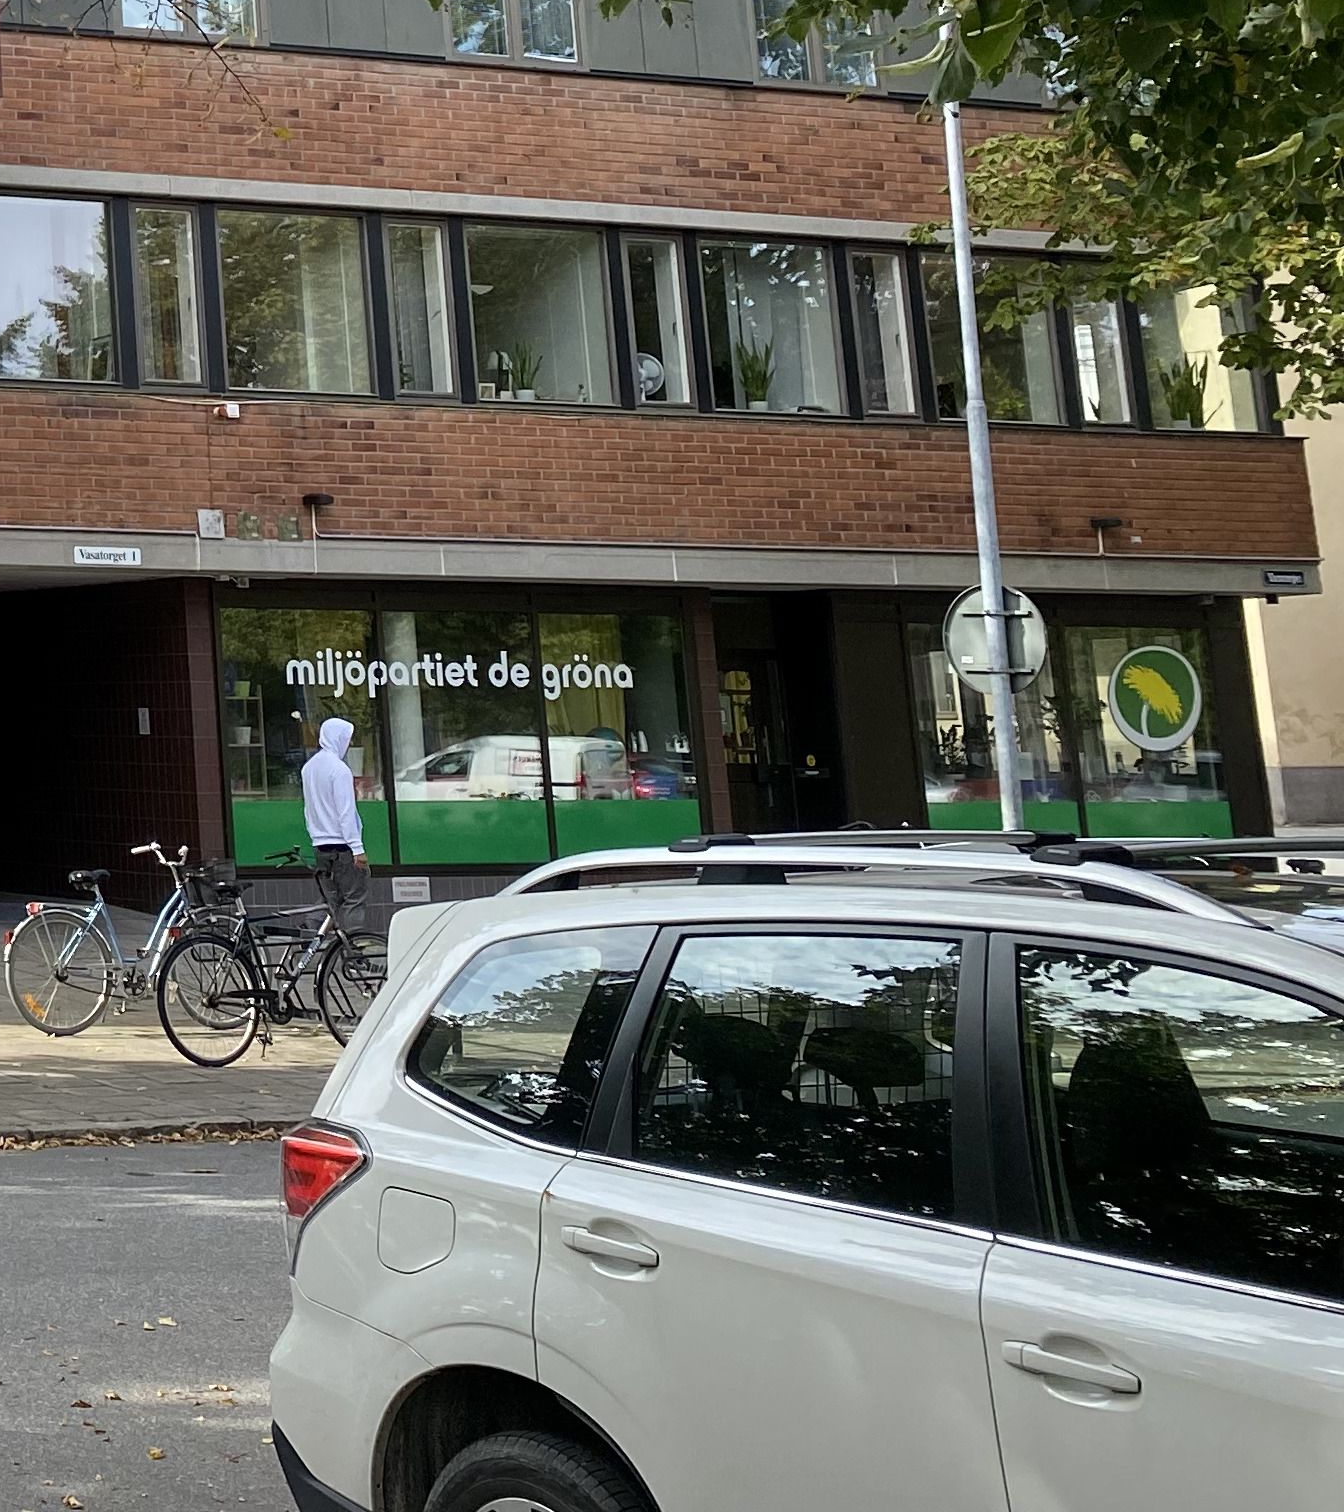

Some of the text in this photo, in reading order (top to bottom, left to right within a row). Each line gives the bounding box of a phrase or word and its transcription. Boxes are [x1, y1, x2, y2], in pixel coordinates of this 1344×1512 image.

[78, 548, 136, 563] Vasatorget 1
[285, 648, 635, 701] miljöpartiet de gröna
